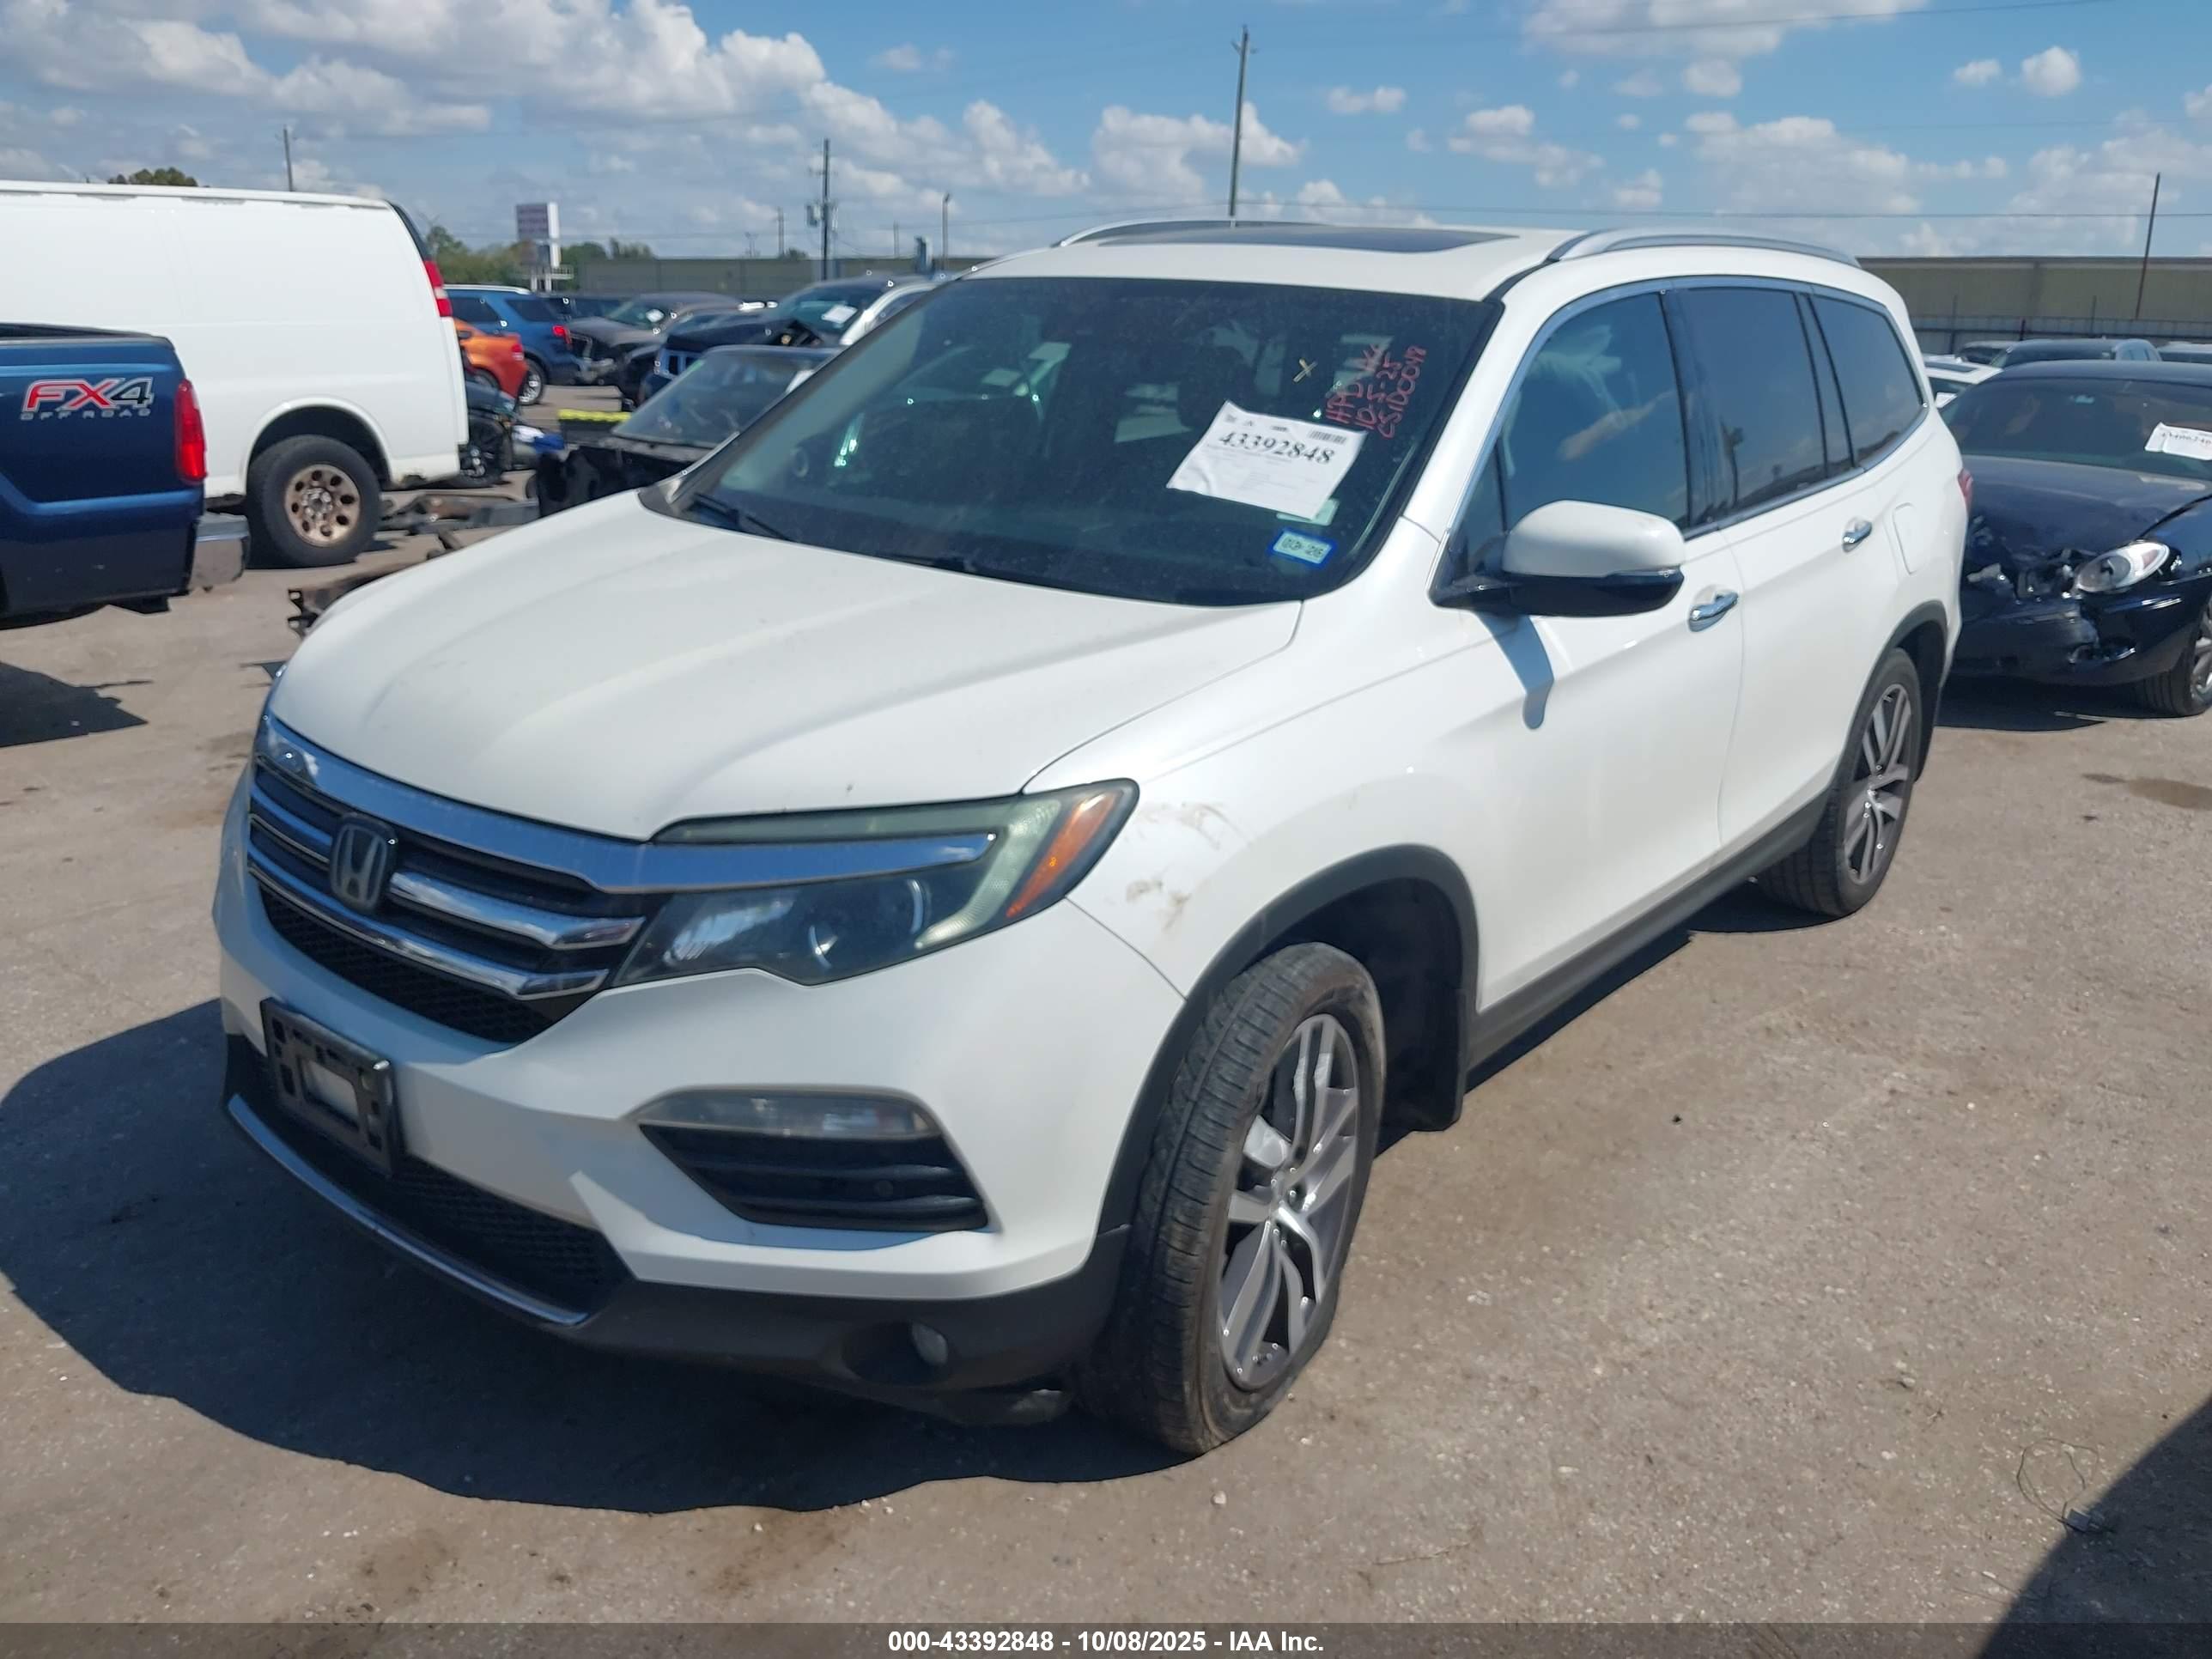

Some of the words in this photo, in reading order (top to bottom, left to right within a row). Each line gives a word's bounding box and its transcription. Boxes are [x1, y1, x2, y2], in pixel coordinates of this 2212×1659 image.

[21, 377, 155, 412] FX4
[20, 410, 71, 421] OFF
[82, 408, 152, 419] ROAD
[1219, 432, 1335, 464] 43392848
